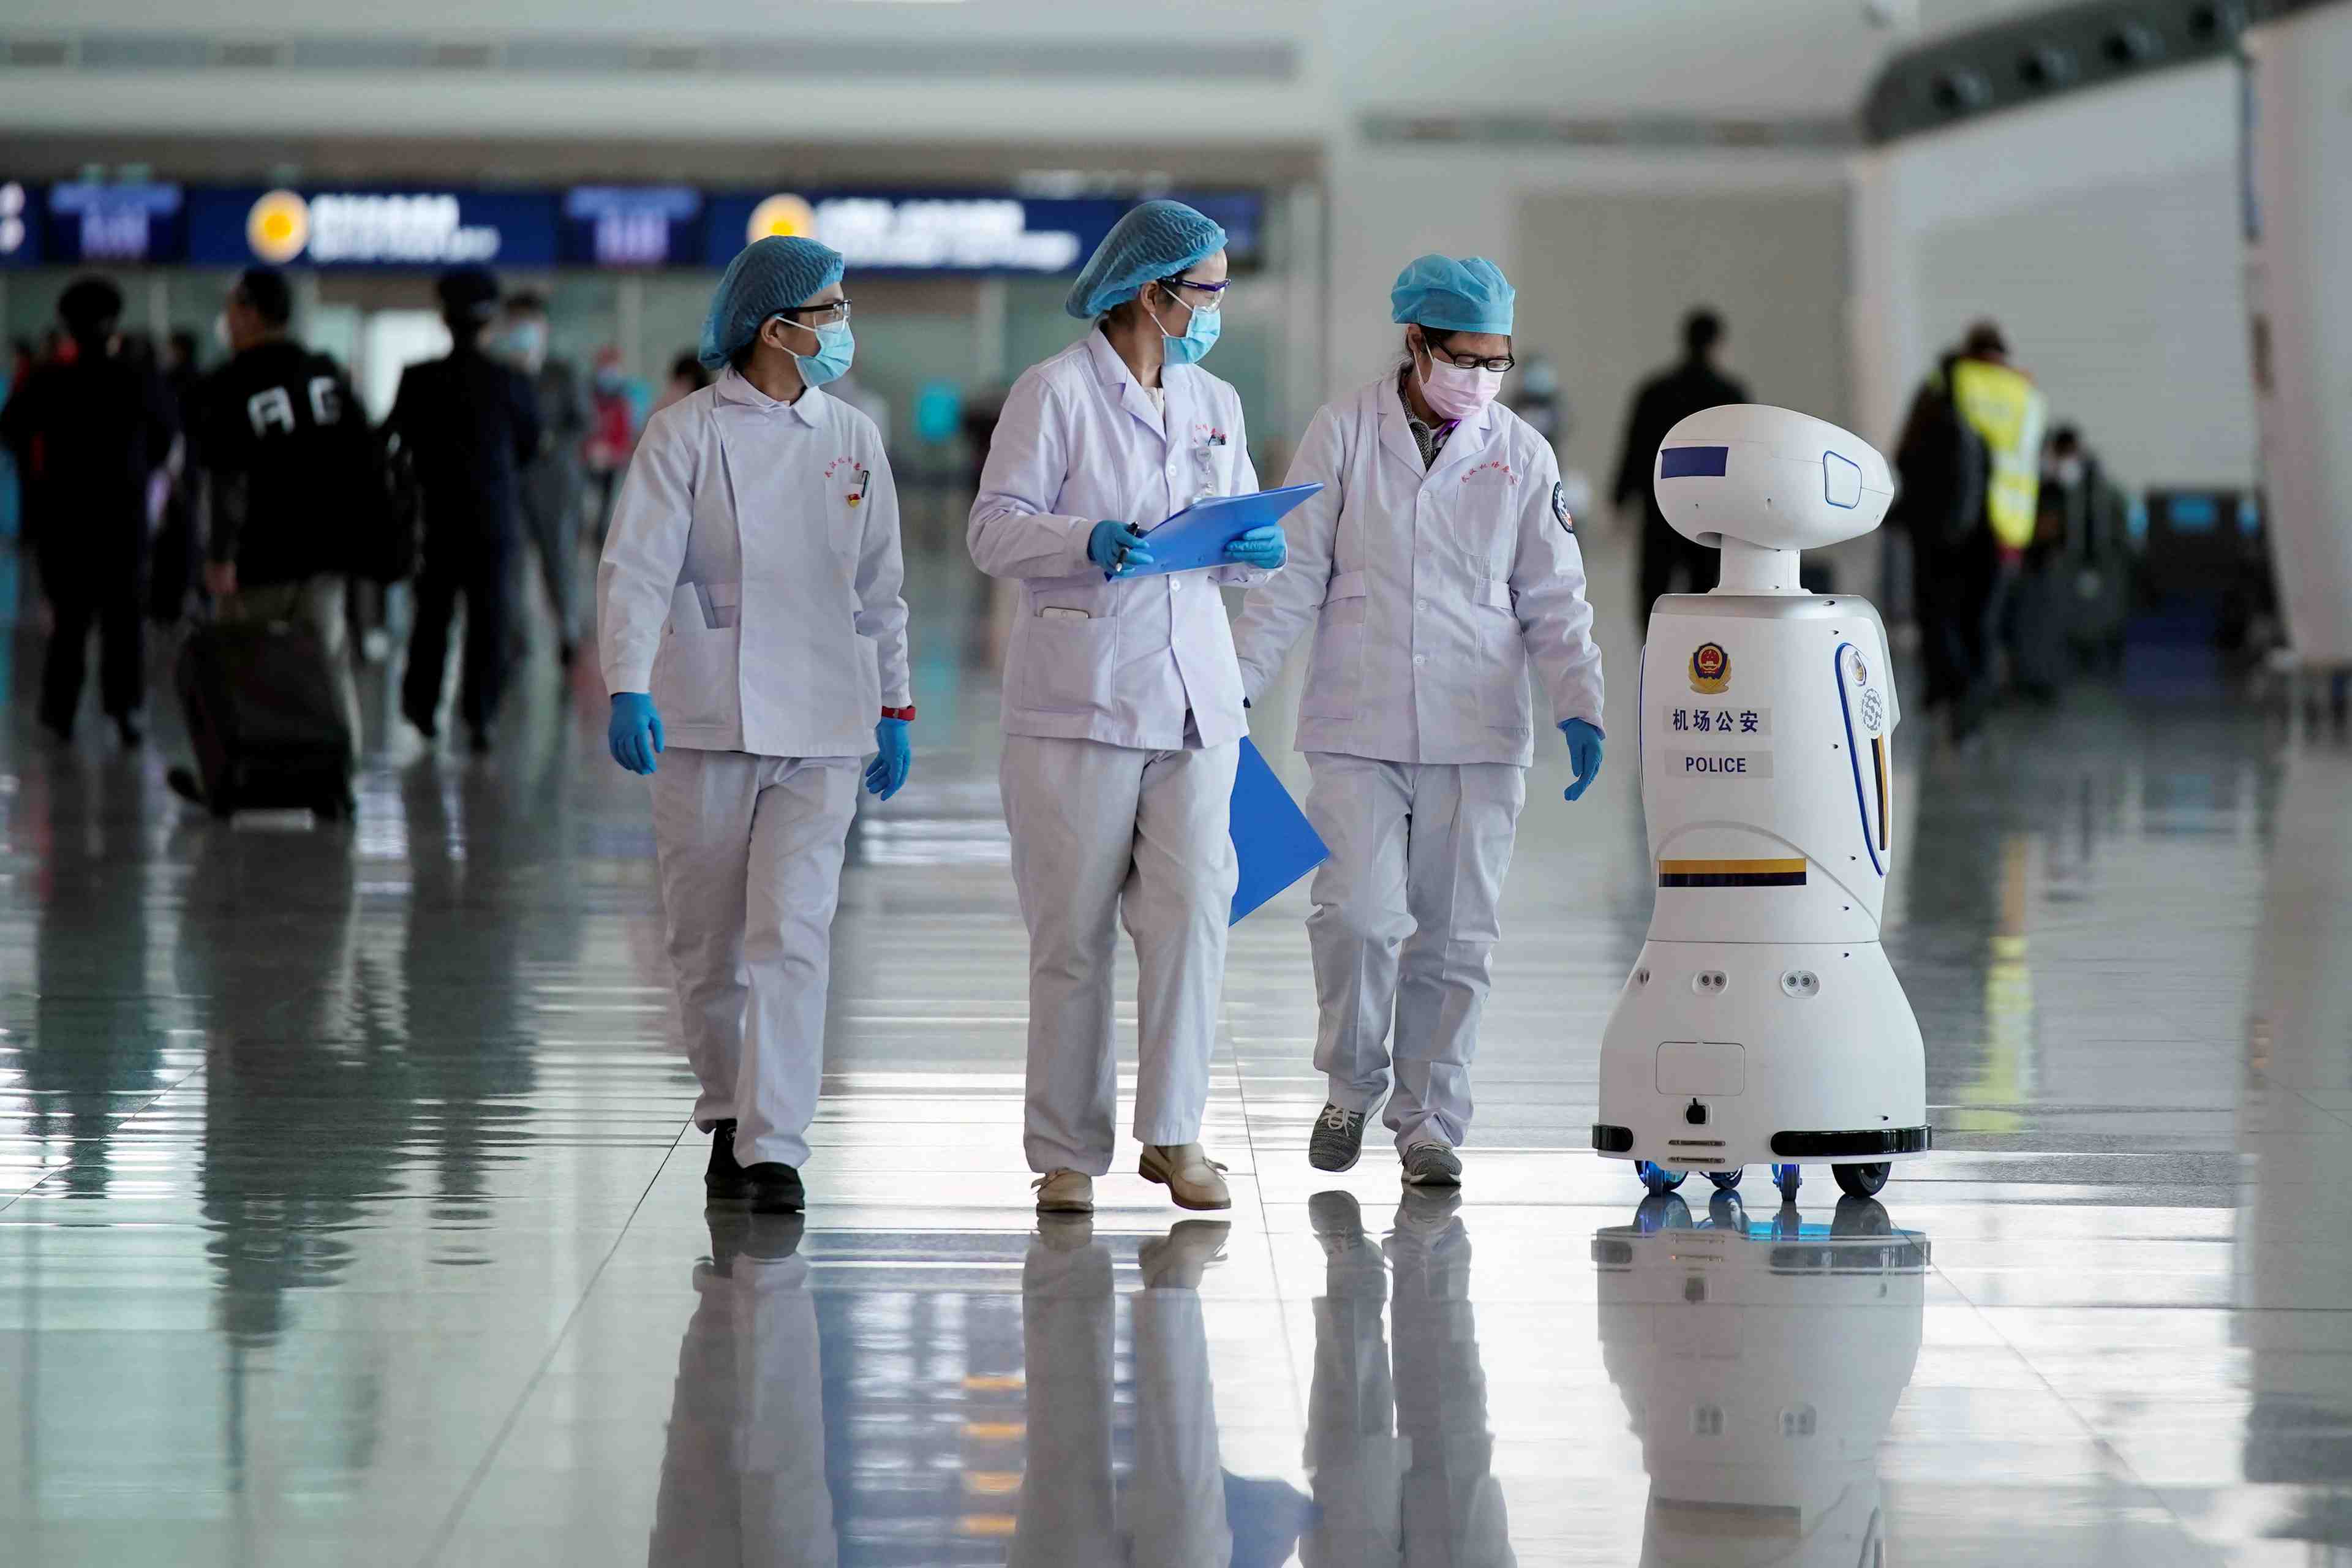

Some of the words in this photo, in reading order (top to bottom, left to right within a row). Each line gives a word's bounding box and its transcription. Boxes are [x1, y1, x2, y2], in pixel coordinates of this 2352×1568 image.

[1673, 709, 1758, 733] 机场公安
[1686, 757, 1747, 773] POLICE
